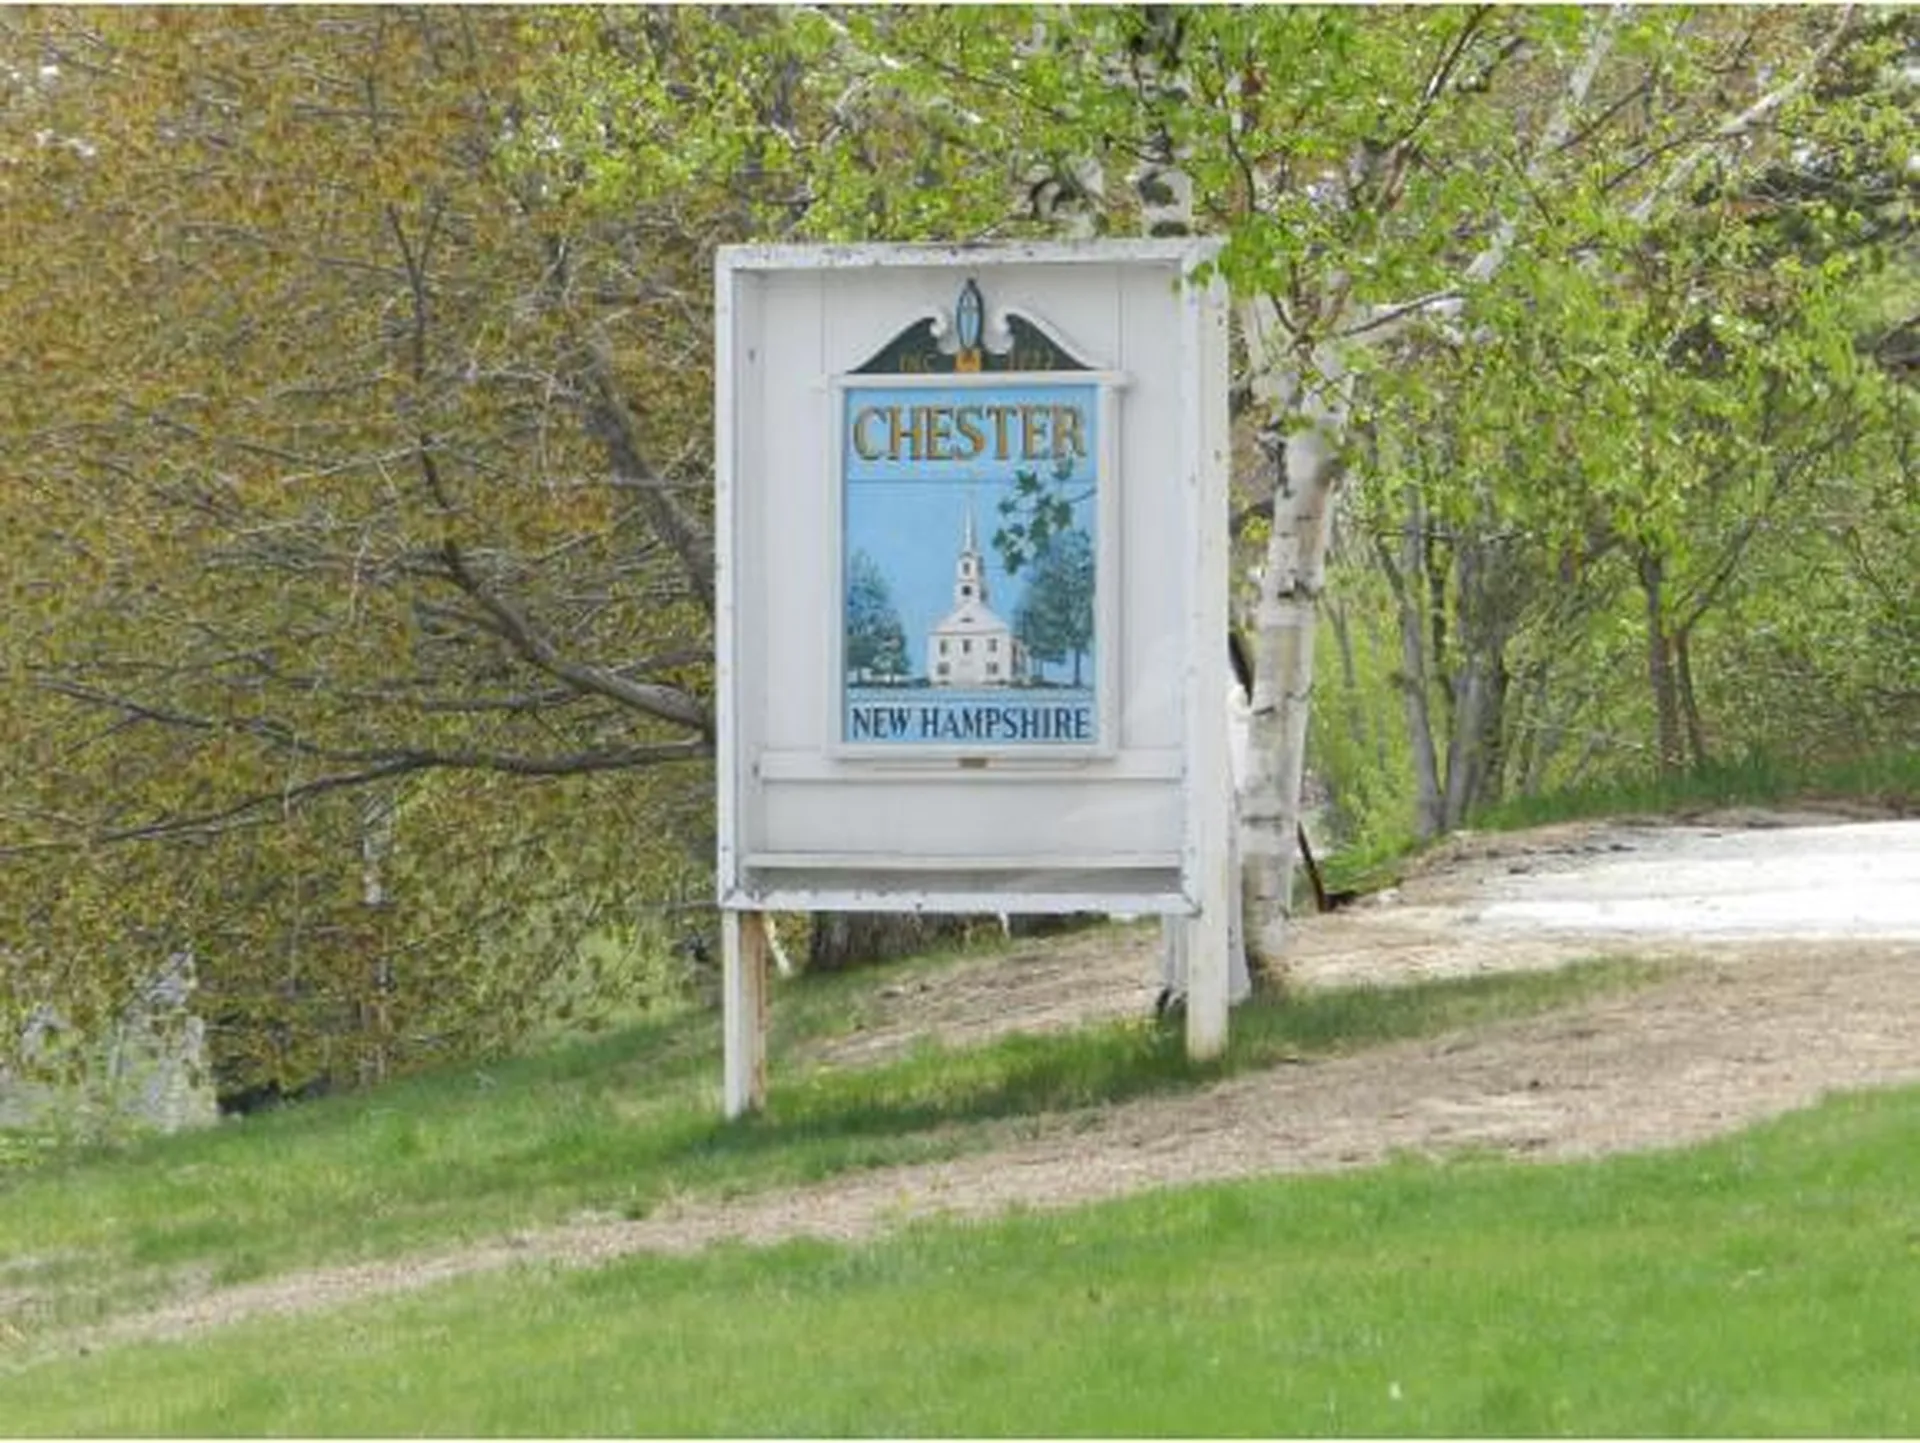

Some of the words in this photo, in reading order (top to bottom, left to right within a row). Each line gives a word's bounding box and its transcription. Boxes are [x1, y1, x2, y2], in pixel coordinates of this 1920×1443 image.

[853, 403, 1087, 461] CHESTER
[852, 706, 909, 739] NEW
[921, 706, 1091, 739] HAMPSHIRE
